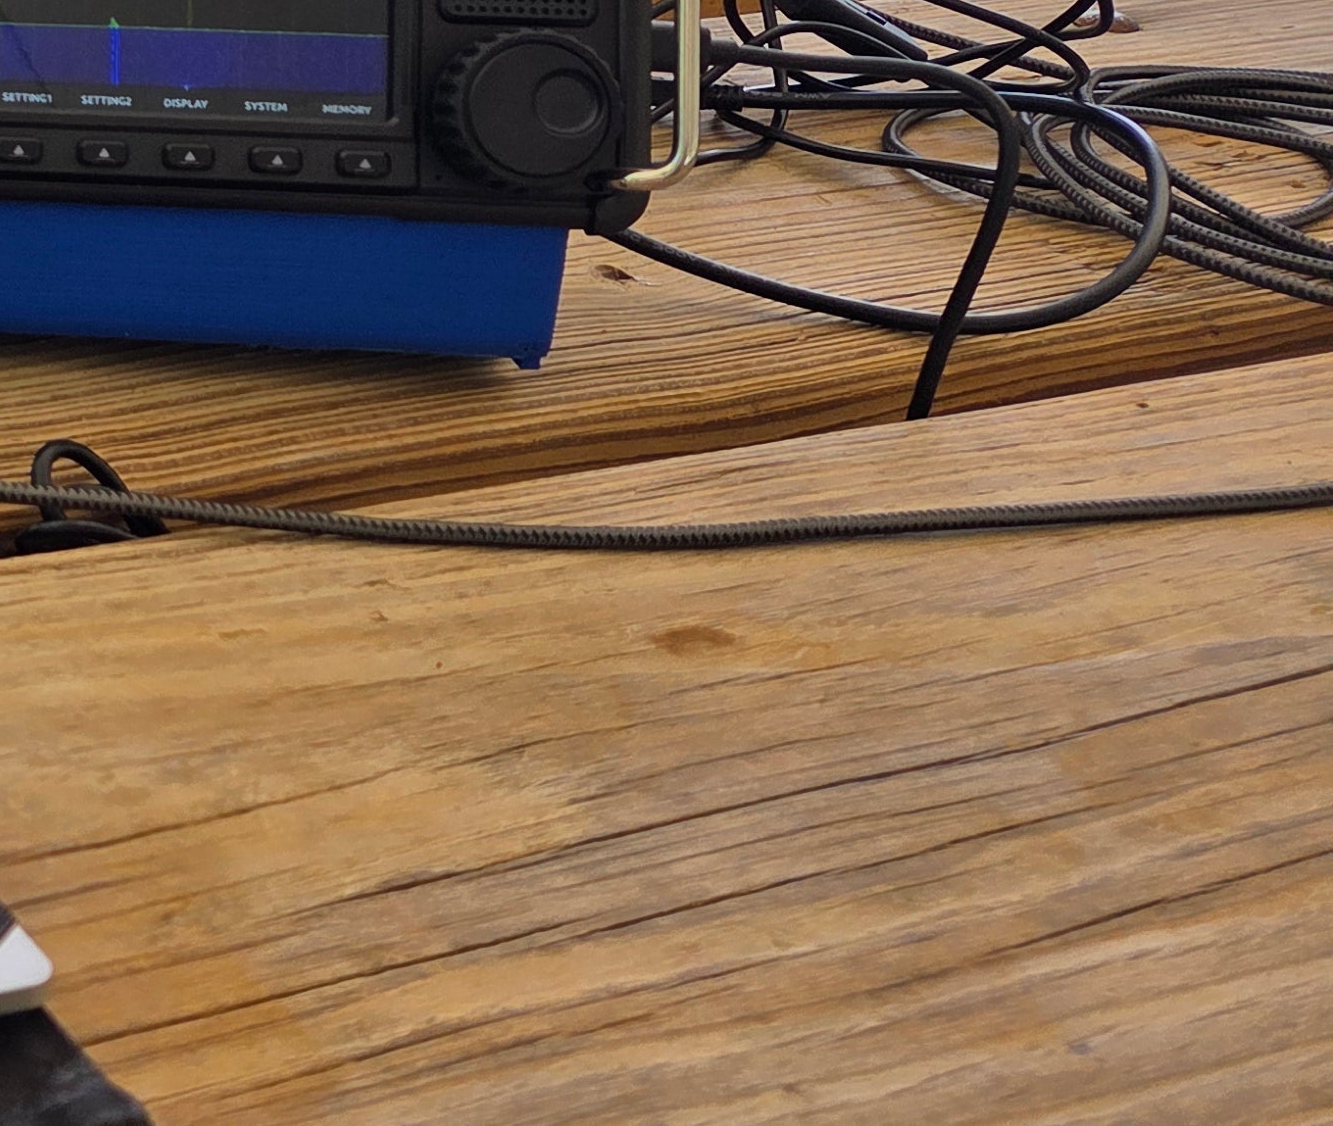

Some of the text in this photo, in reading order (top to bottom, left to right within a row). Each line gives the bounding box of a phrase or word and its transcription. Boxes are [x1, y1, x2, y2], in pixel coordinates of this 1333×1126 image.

[1, 90, 53, 104] SETTING1
[81, 94, 132, 106] SETTING2
[163, 97, 209, 110] DISPLAY
[245, 100, 288, 112] SYSTEM
[322, 103, 373, 115] MEMORY
